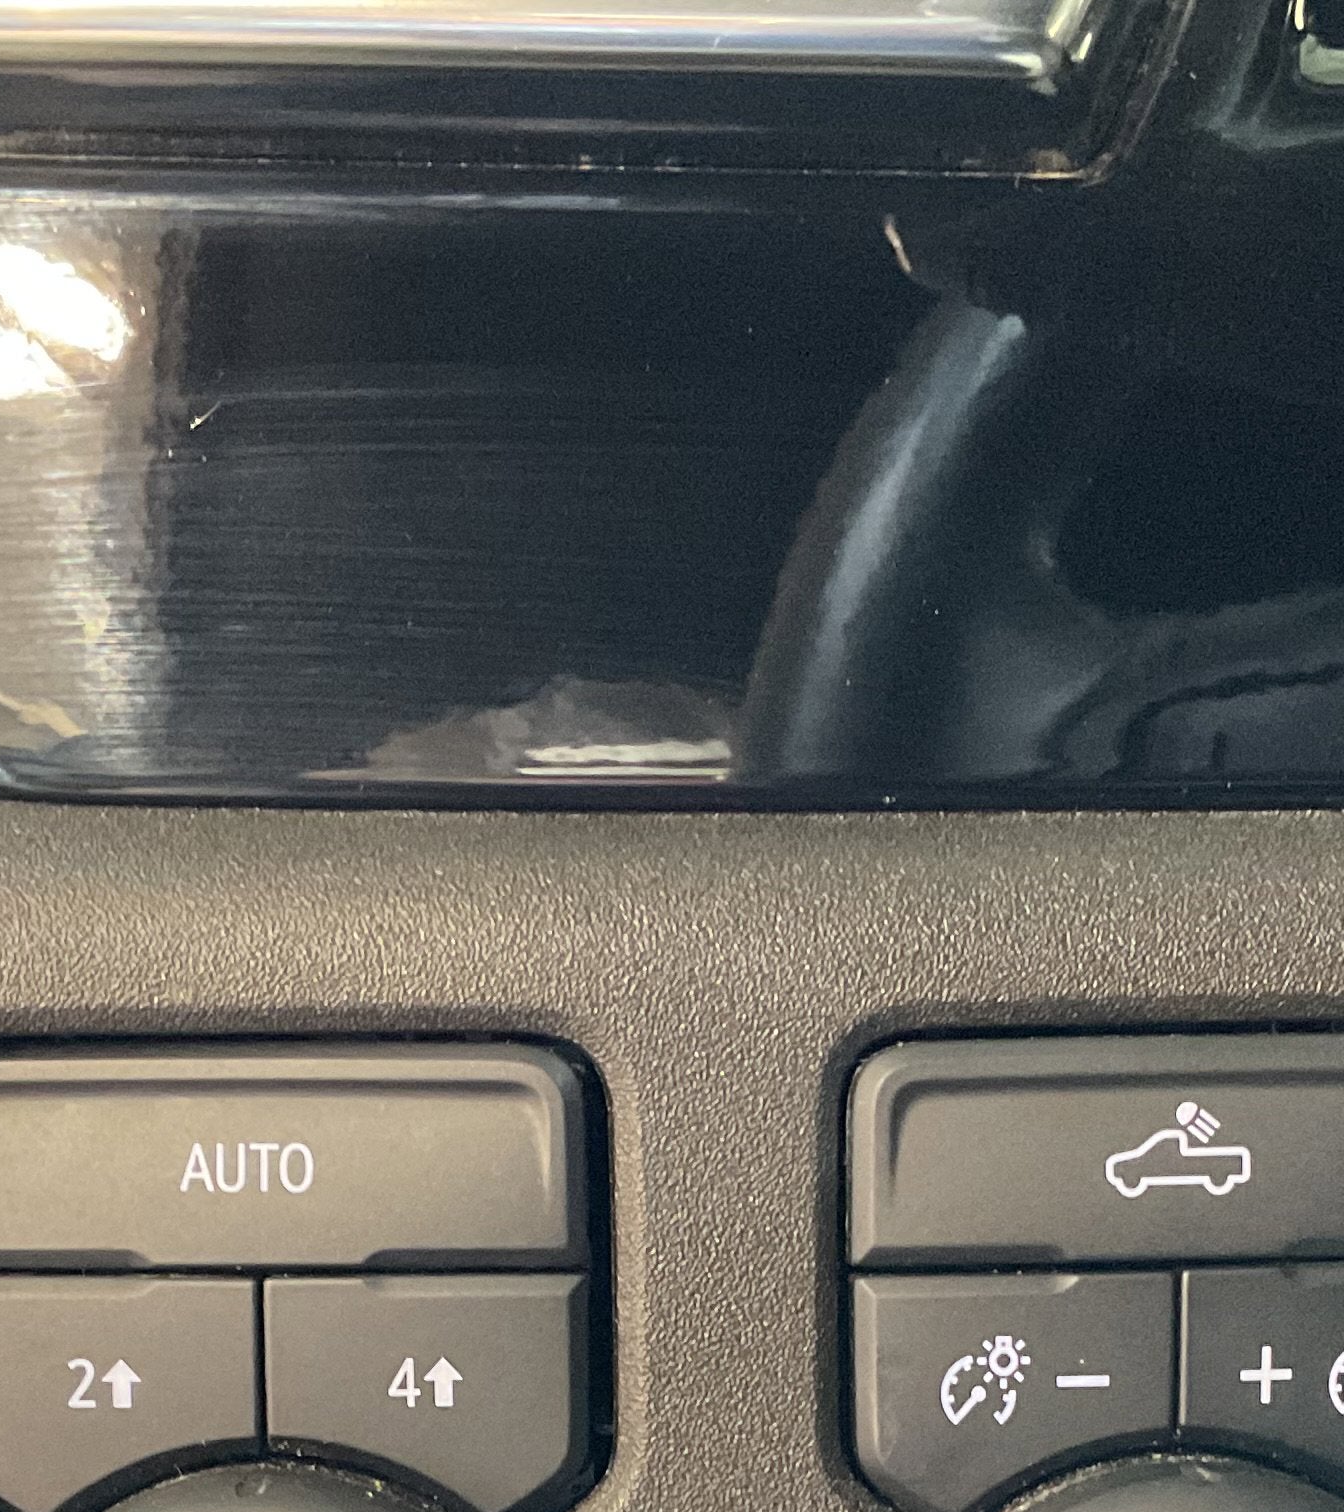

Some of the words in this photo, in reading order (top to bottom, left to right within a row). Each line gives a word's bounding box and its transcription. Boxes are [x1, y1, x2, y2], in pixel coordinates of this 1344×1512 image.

[179, 1142, 315, 1194] AUTO
[67, 1358, 97, 1408] 2
[387, 1357, 422, 1408] 4
